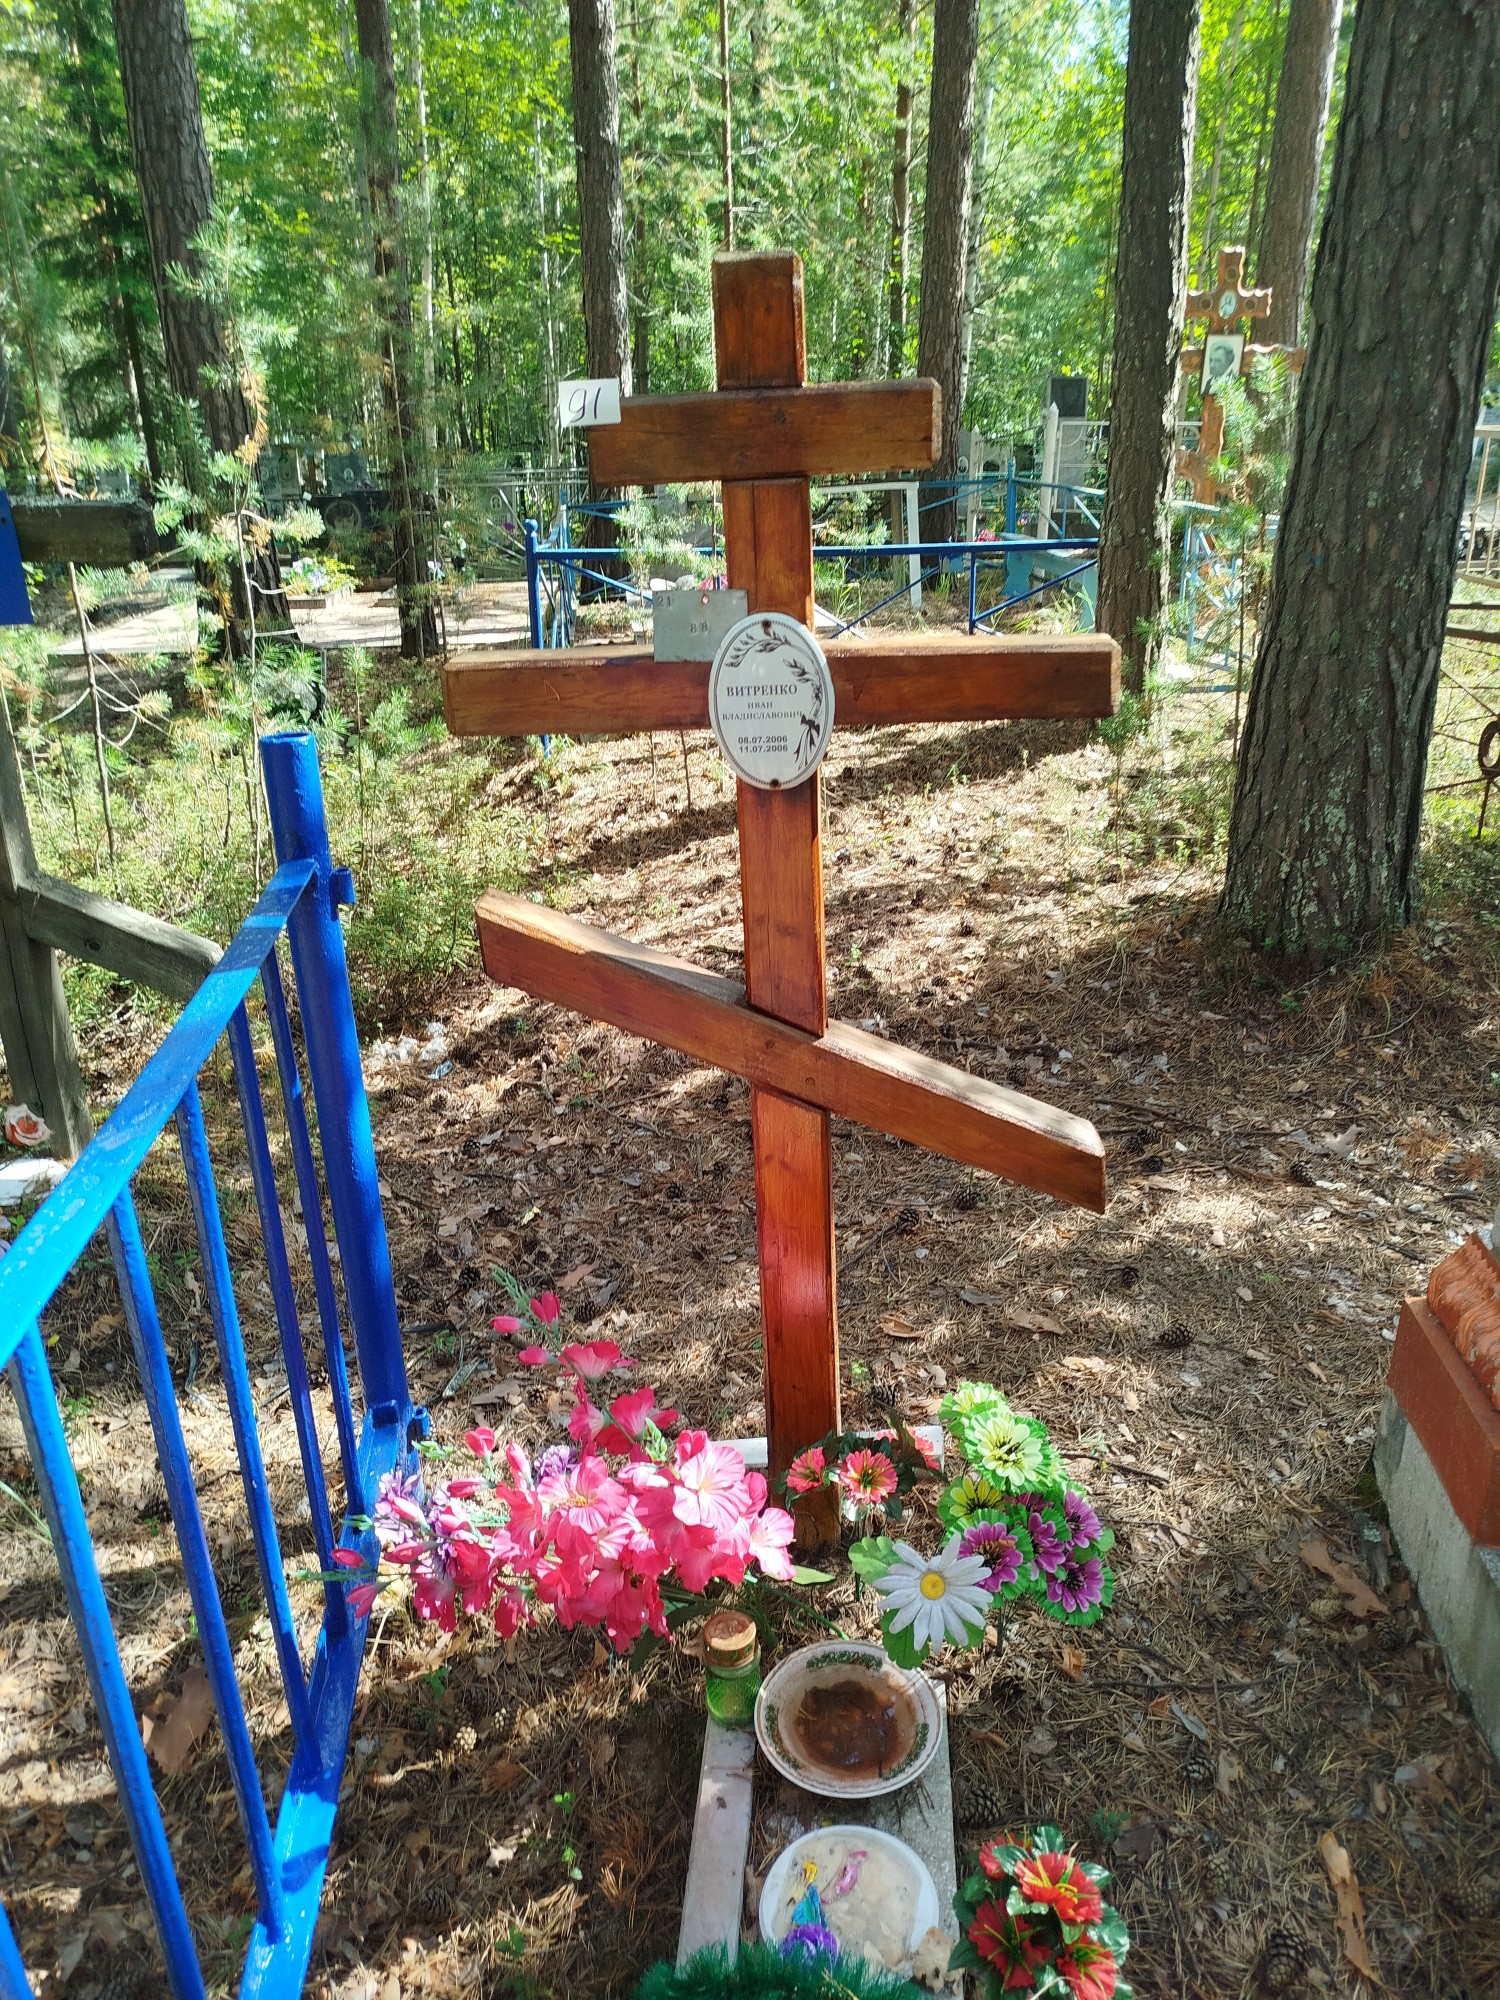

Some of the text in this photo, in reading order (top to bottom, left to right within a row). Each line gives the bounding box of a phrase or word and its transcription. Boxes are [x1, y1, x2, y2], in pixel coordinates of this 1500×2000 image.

[568, 387, 602, 423] 91
[727, 684, 798, 697] ВИТРЕНКО
[747, 701, 773, 710] ИВАН
[722, 711, 802, 721] ВЛАДИСЛАВОВИЧ
[738, 735, 788, 744] 08.07.2006
[739, 744, 788, 753] 11.07.2006
